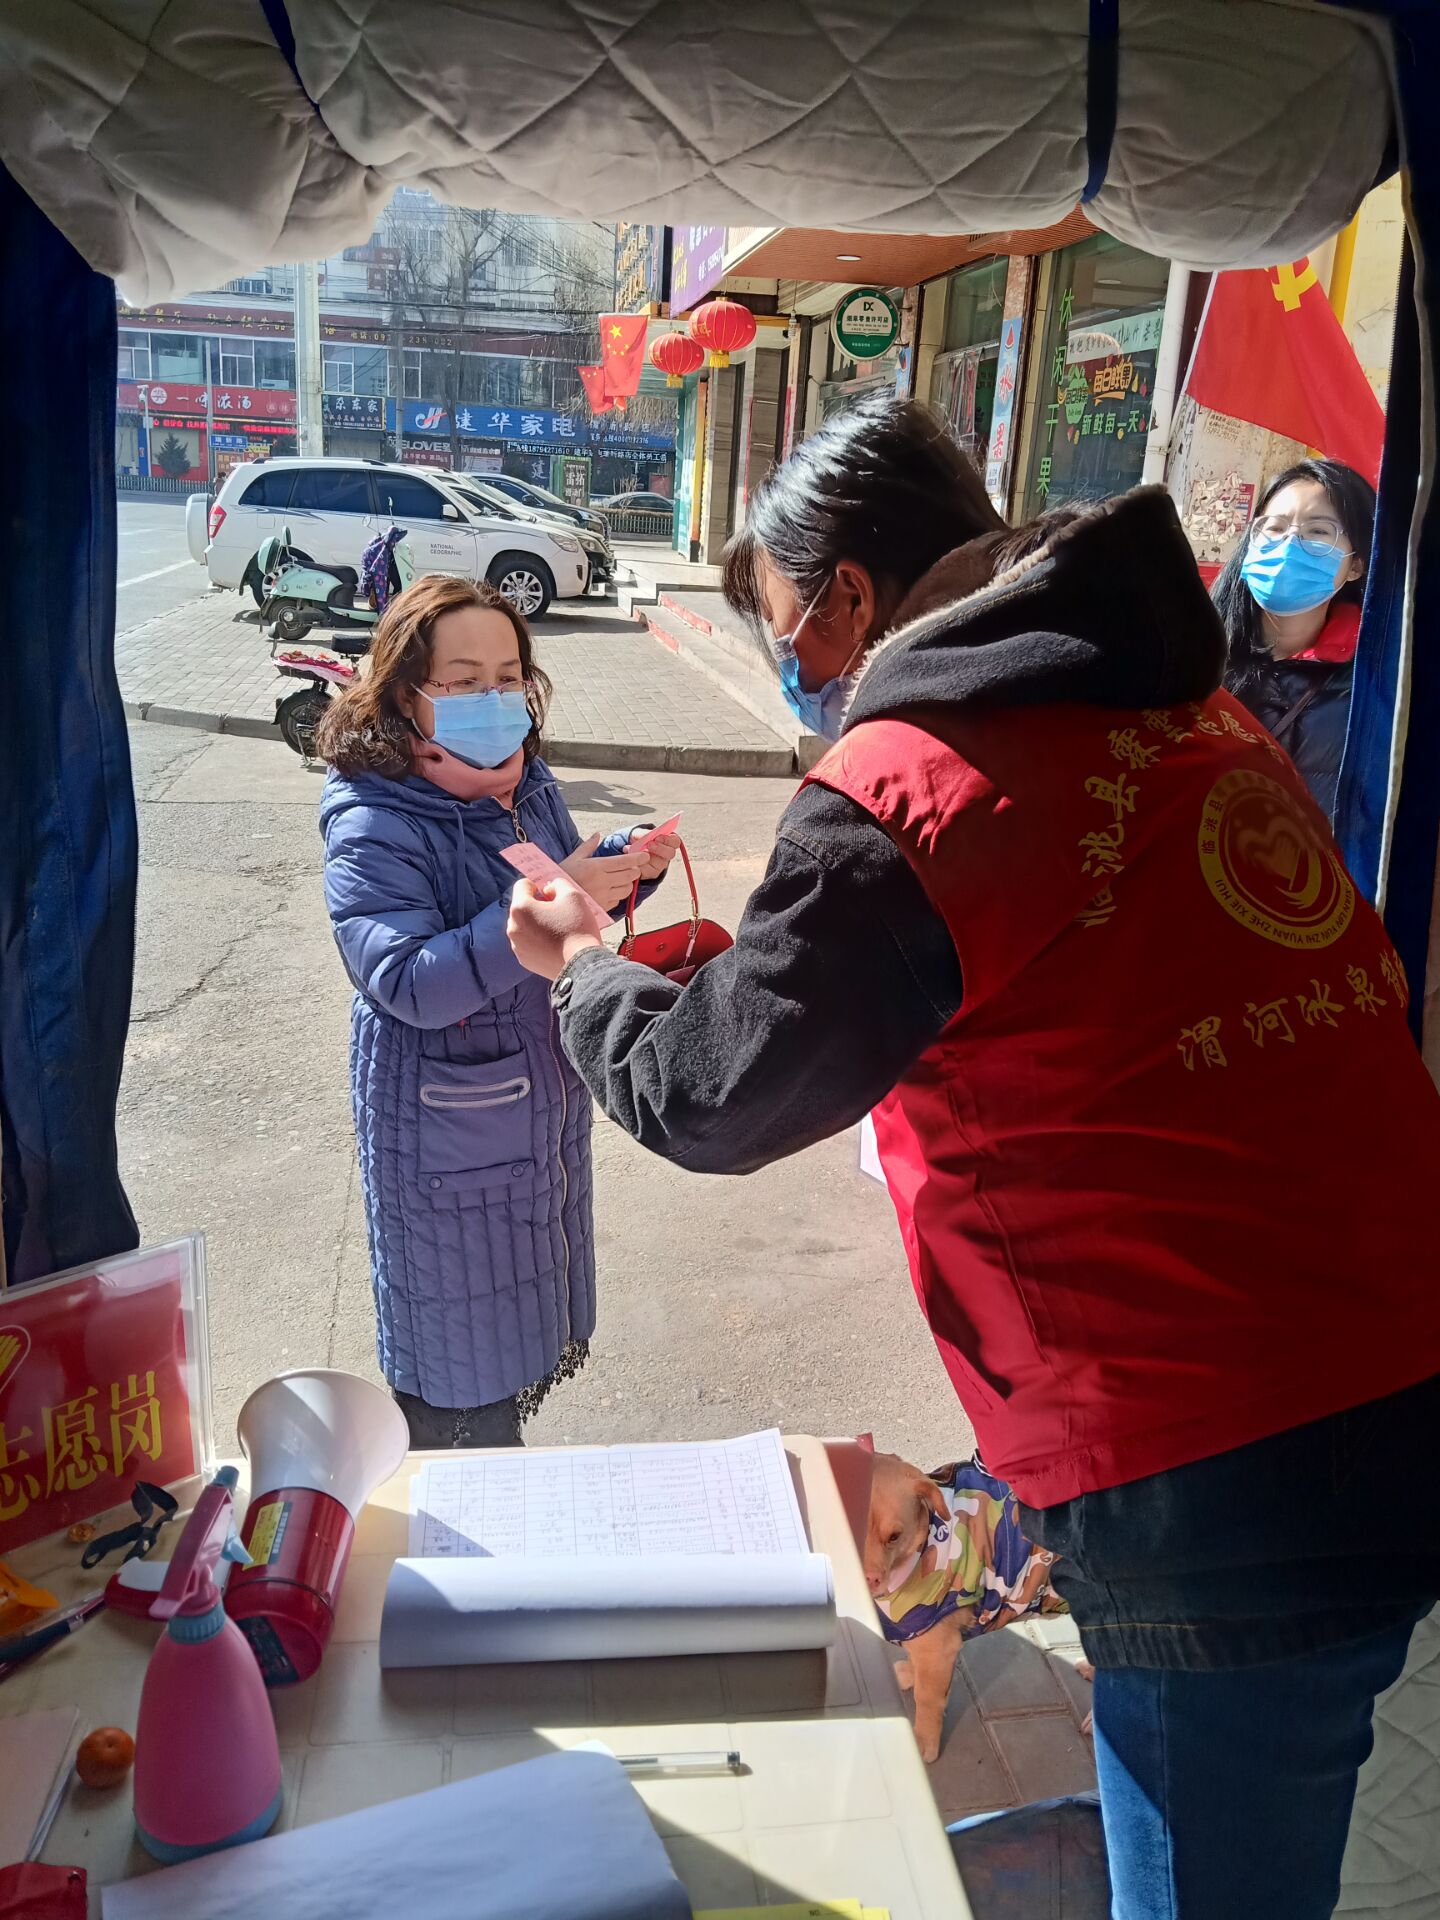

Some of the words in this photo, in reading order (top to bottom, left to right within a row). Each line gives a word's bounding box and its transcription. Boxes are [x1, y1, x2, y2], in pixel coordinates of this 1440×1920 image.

[1036, 287, 1074, 497] 休闲干果
[455, 408, 576, 438] 建华家电
[1081, 410, 1140, 436] 新鲜每一天
[1214, 879, 1232, 901] HUI
[1230, 898, 1249, 918] XIE
[1249, 915, 1272, 932] ZHE
[1273, 927, 1304, 945] YUAN
